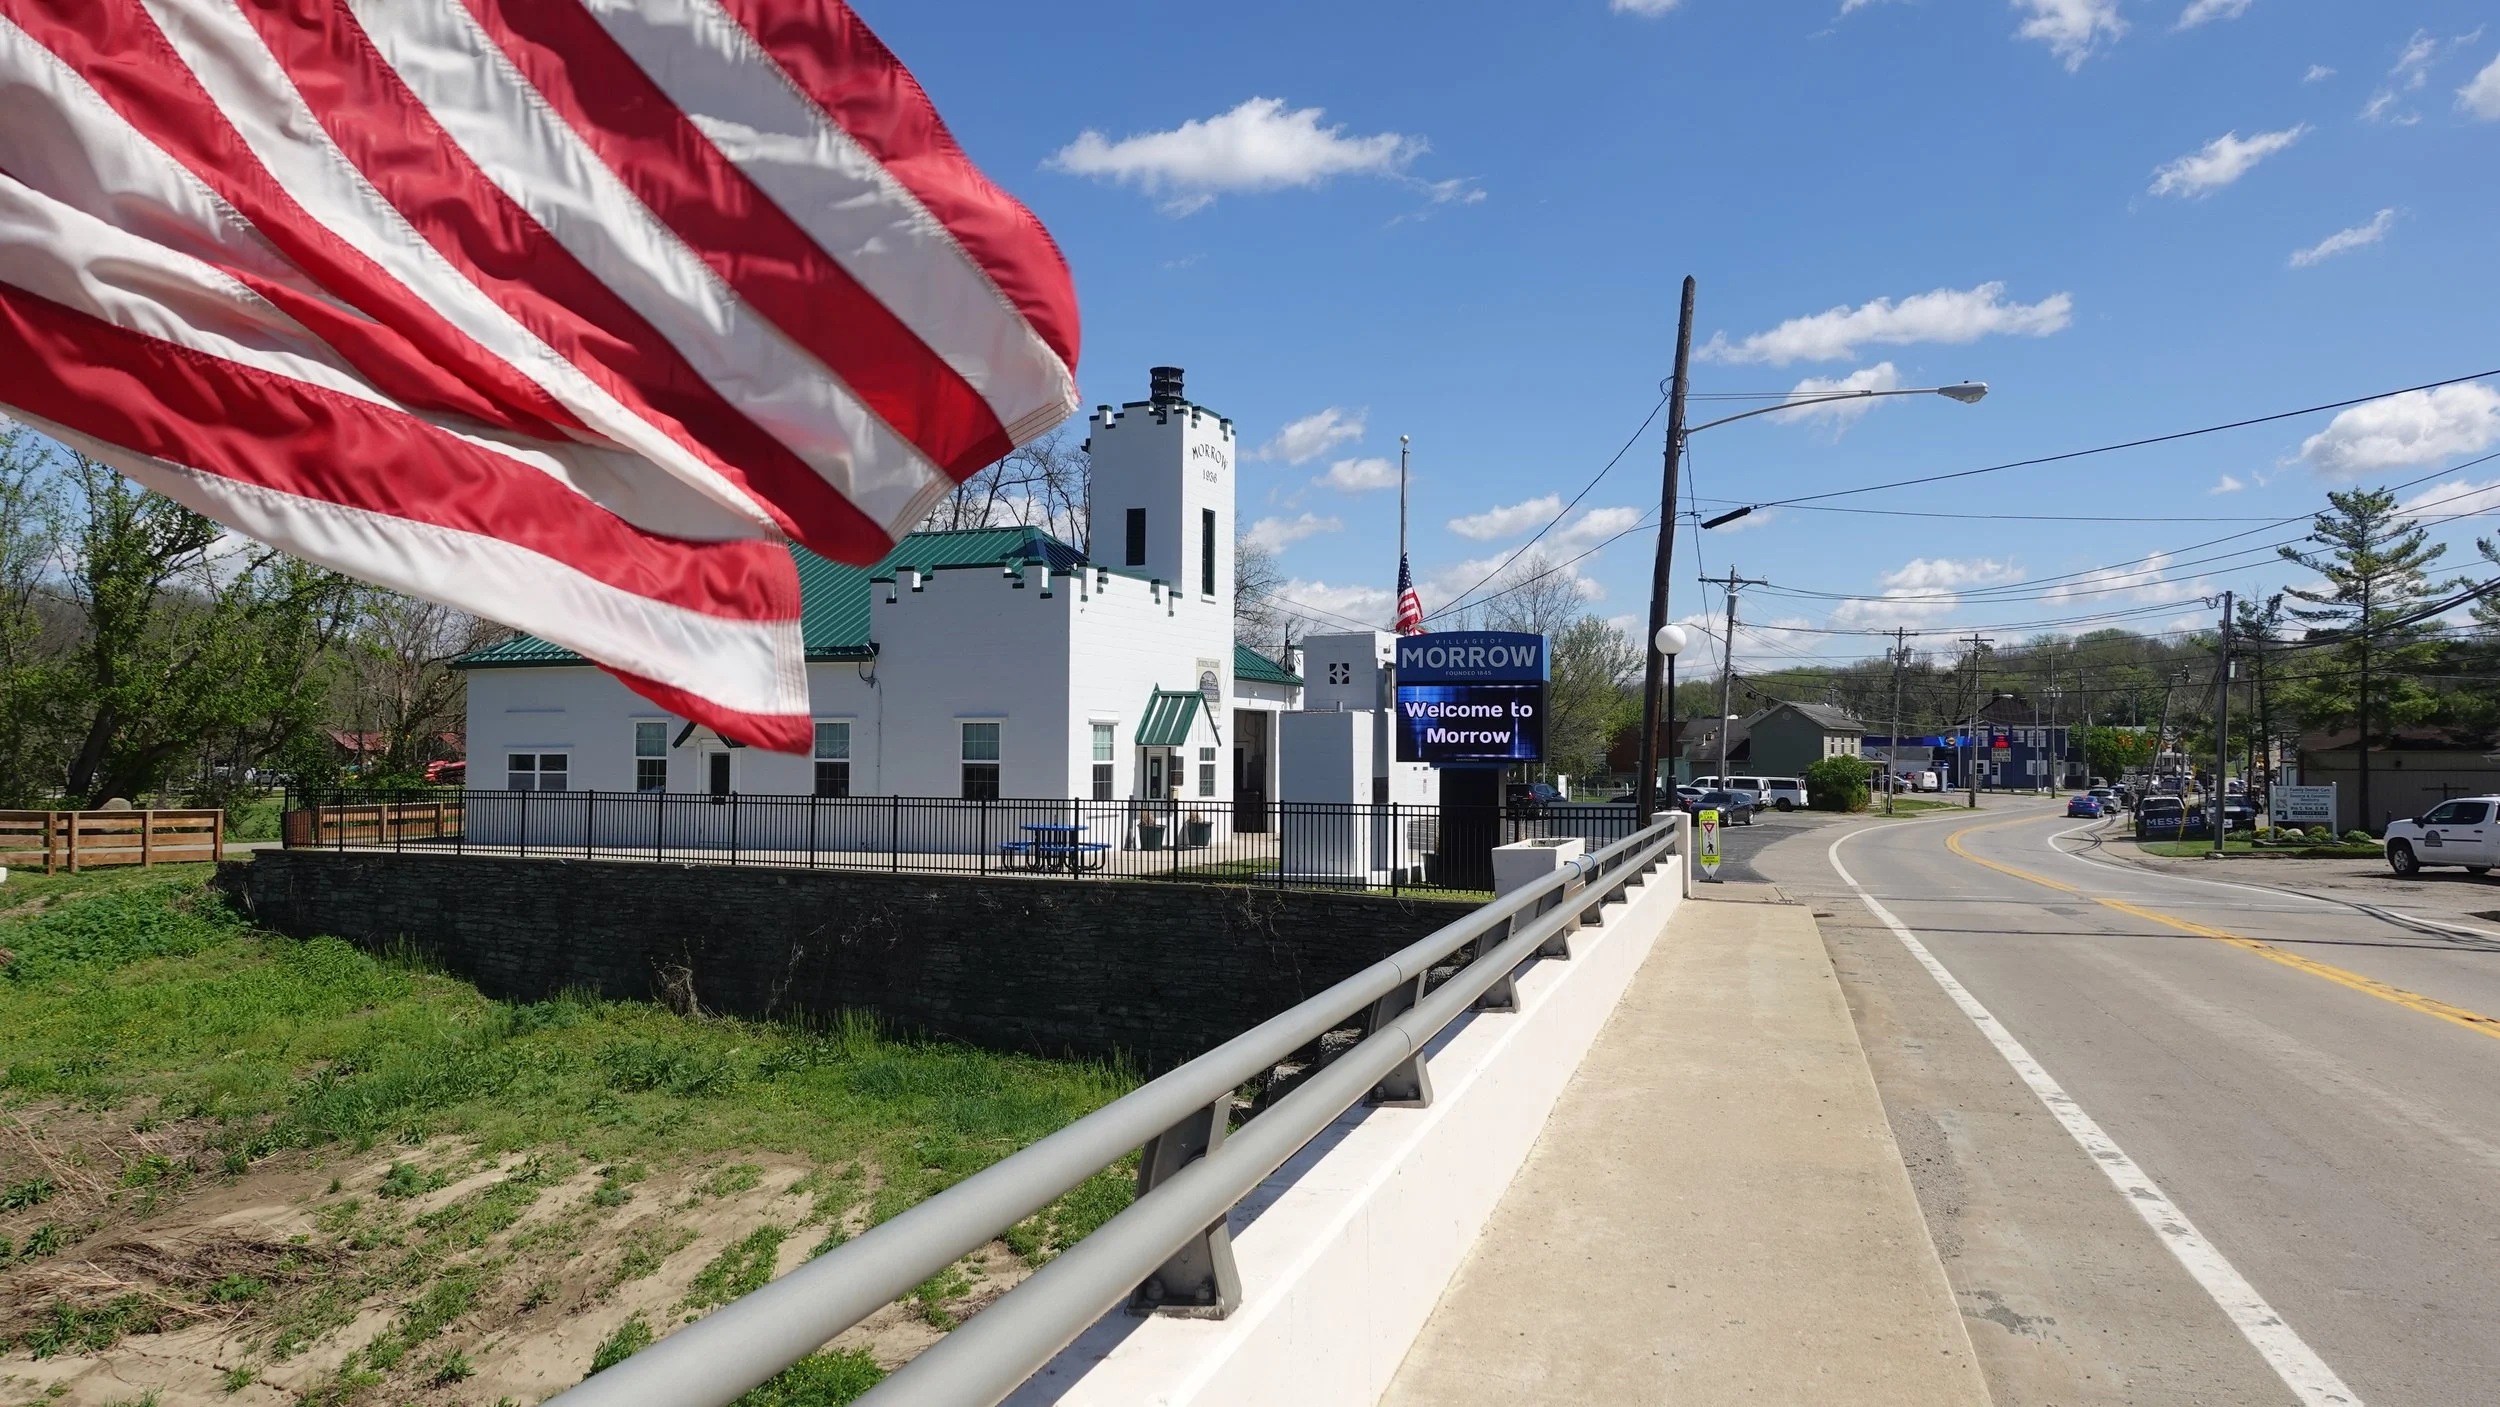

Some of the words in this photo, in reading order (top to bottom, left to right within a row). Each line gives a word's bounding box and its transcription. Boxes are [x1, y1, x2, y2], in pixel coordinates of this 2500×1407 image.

[1192, 444, 1228, 470] MORROW
[1402, 646, 1537, 669] MORROW
[1405, 702, 1503, 718] Welcome
[1511, 701, 1533, 718] to
[1426, 728, 1511, 744] Morrow
[2146, 816, 2200, 826] MESSER
